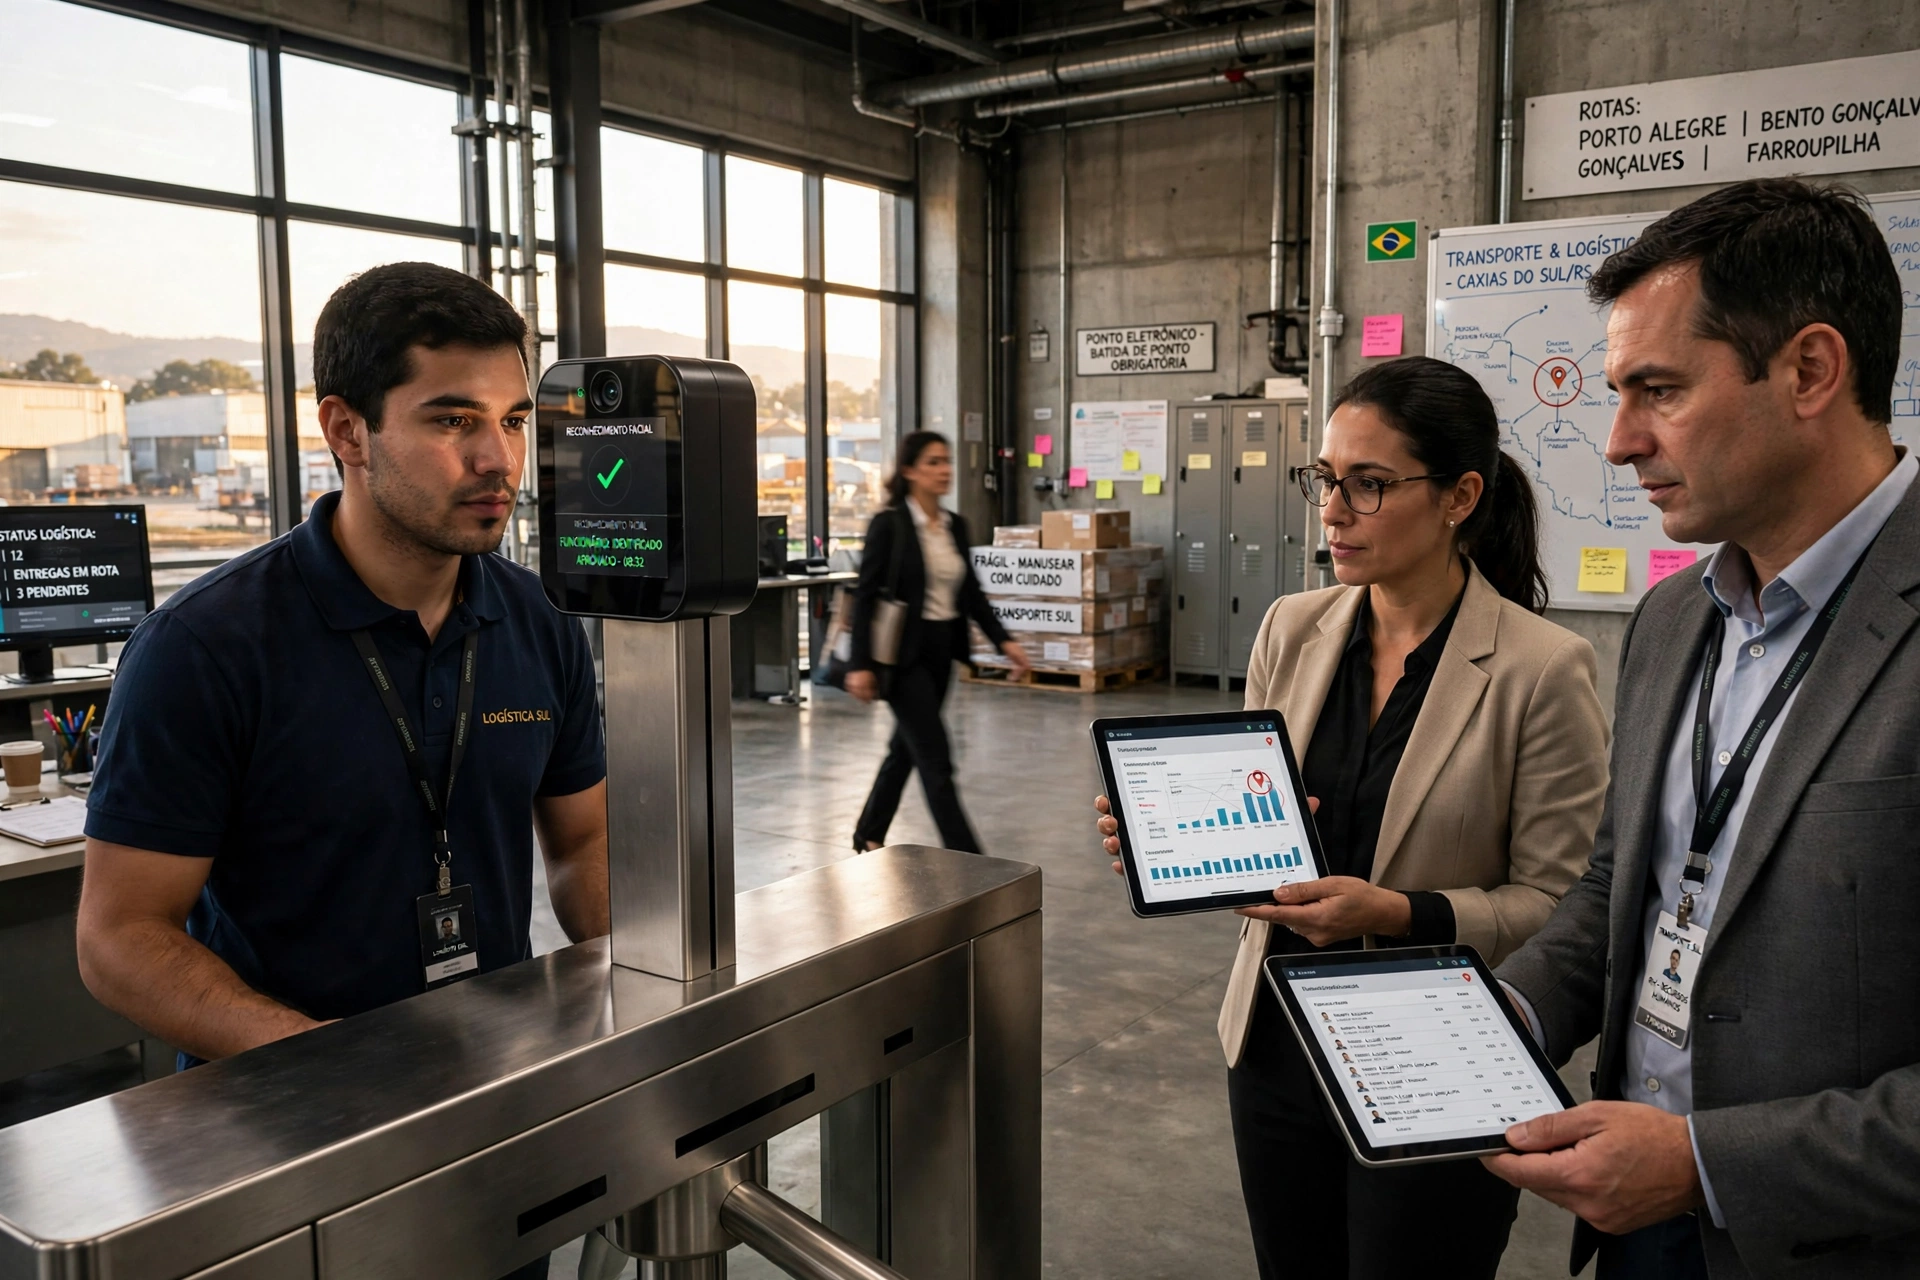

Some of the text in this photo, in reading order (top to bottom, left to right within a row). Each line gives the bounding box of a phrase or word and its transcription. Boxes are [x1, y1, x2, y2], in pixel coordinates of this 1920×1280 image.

[1579, 97, 1641, 121] ROTAS:
[1579, 125, 1641, 150] PORTO
[1649, 115, 1727, 142] ALEGRE
[1761, 106, 1824, 132] BENTO
[1578, 150, 1684, 180] GONÇALVES
[1747, 131, 1880, 163] FARROUPILHA
[1446, 244, 1543, 267] TRANSPORTE
[1550, 243, 1561, 259] &
[1457, 271, 1508, 289] CAXIAS
[1514, 269, 1534, 285] DO
[1540, 264, 1593, 283] SUL/RS
[1086, 332, 1123, 345] PONTO
[1127, 327, 1197, 343] ELETRÔNICO
[1090, 342, 1191, 359] BATIDA DE PONTO
[1111, 356, 1188, 371] OBRIGATÓRIA
[40, 525, 97, 540] LOGÍSTICA:
[10, 550, 24, 561] 12
[974, 552, 1009, 568] FRÁGIL
[1018, 557, 1075, 570] MANUSEAR
[13, 567, 71, 580] ENTREGAS
[72, 566, 89, 577] EM
[91, 565, 120, 577] ROTA
[990, 572, 1062, 586] COM CUIDADO
[16, 588, 25, 599] 3
[26, 584, 90, 599] PENDENTES
[1056, 611, 1075, 623] SUL
[482, 708, 535, 724] LOGÍSTICA
